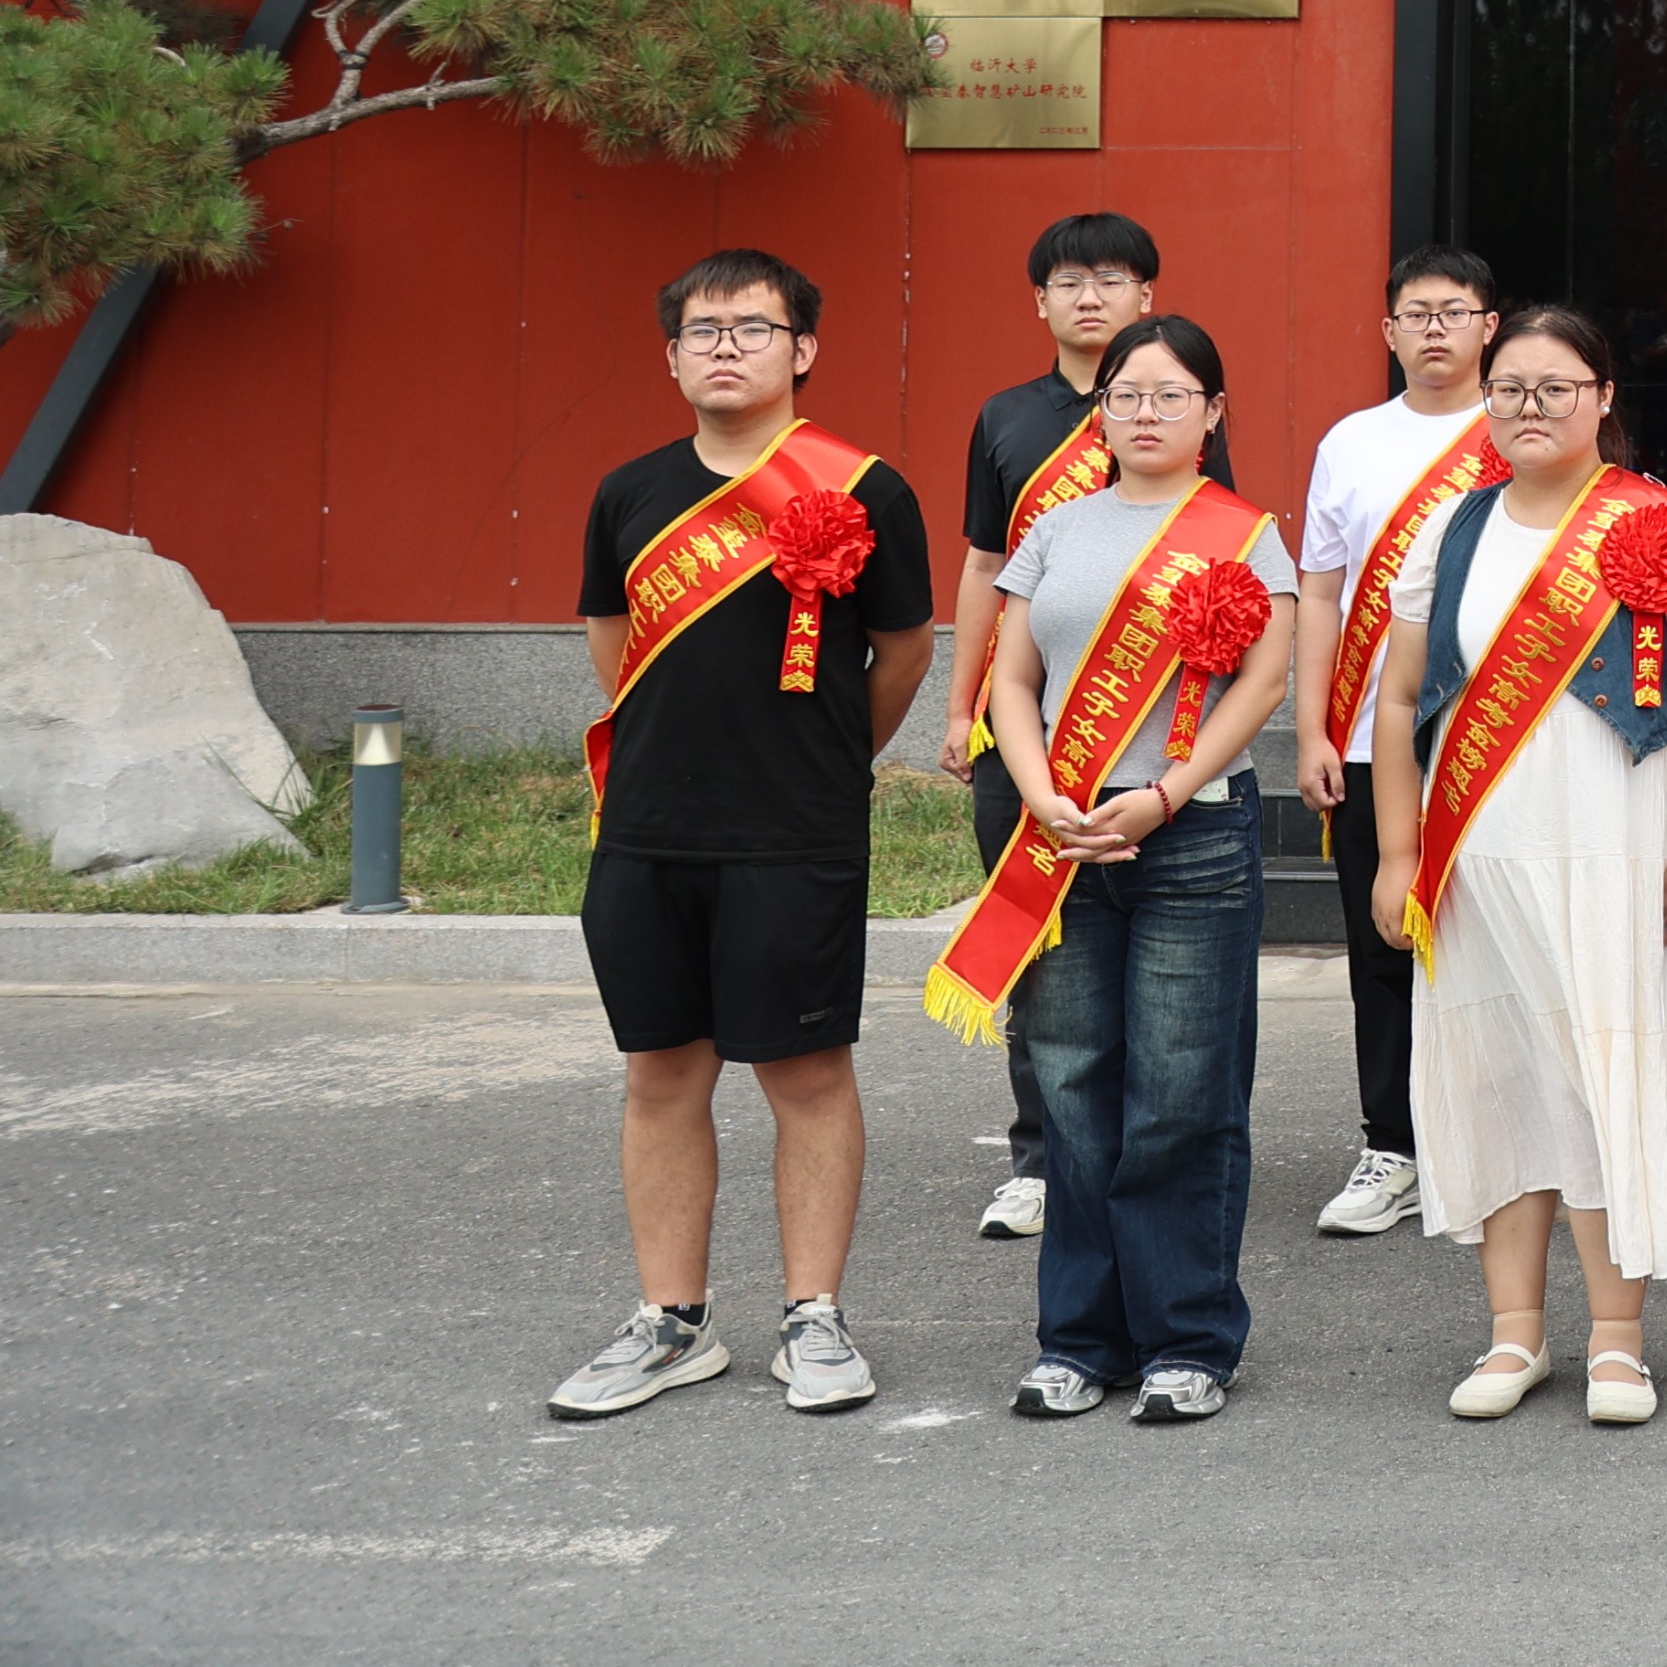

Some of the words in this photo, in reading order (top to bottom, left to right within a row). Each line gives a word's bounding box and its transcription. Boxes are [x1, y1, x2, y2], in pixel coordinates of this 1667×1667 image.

[970, 58, 1038, 74] 临沂大学
[786, 612, 818, 668] 光荣
[1635, 625, 1662, 682] 光荣
[1172, 681, 1203, 739] 光荣
